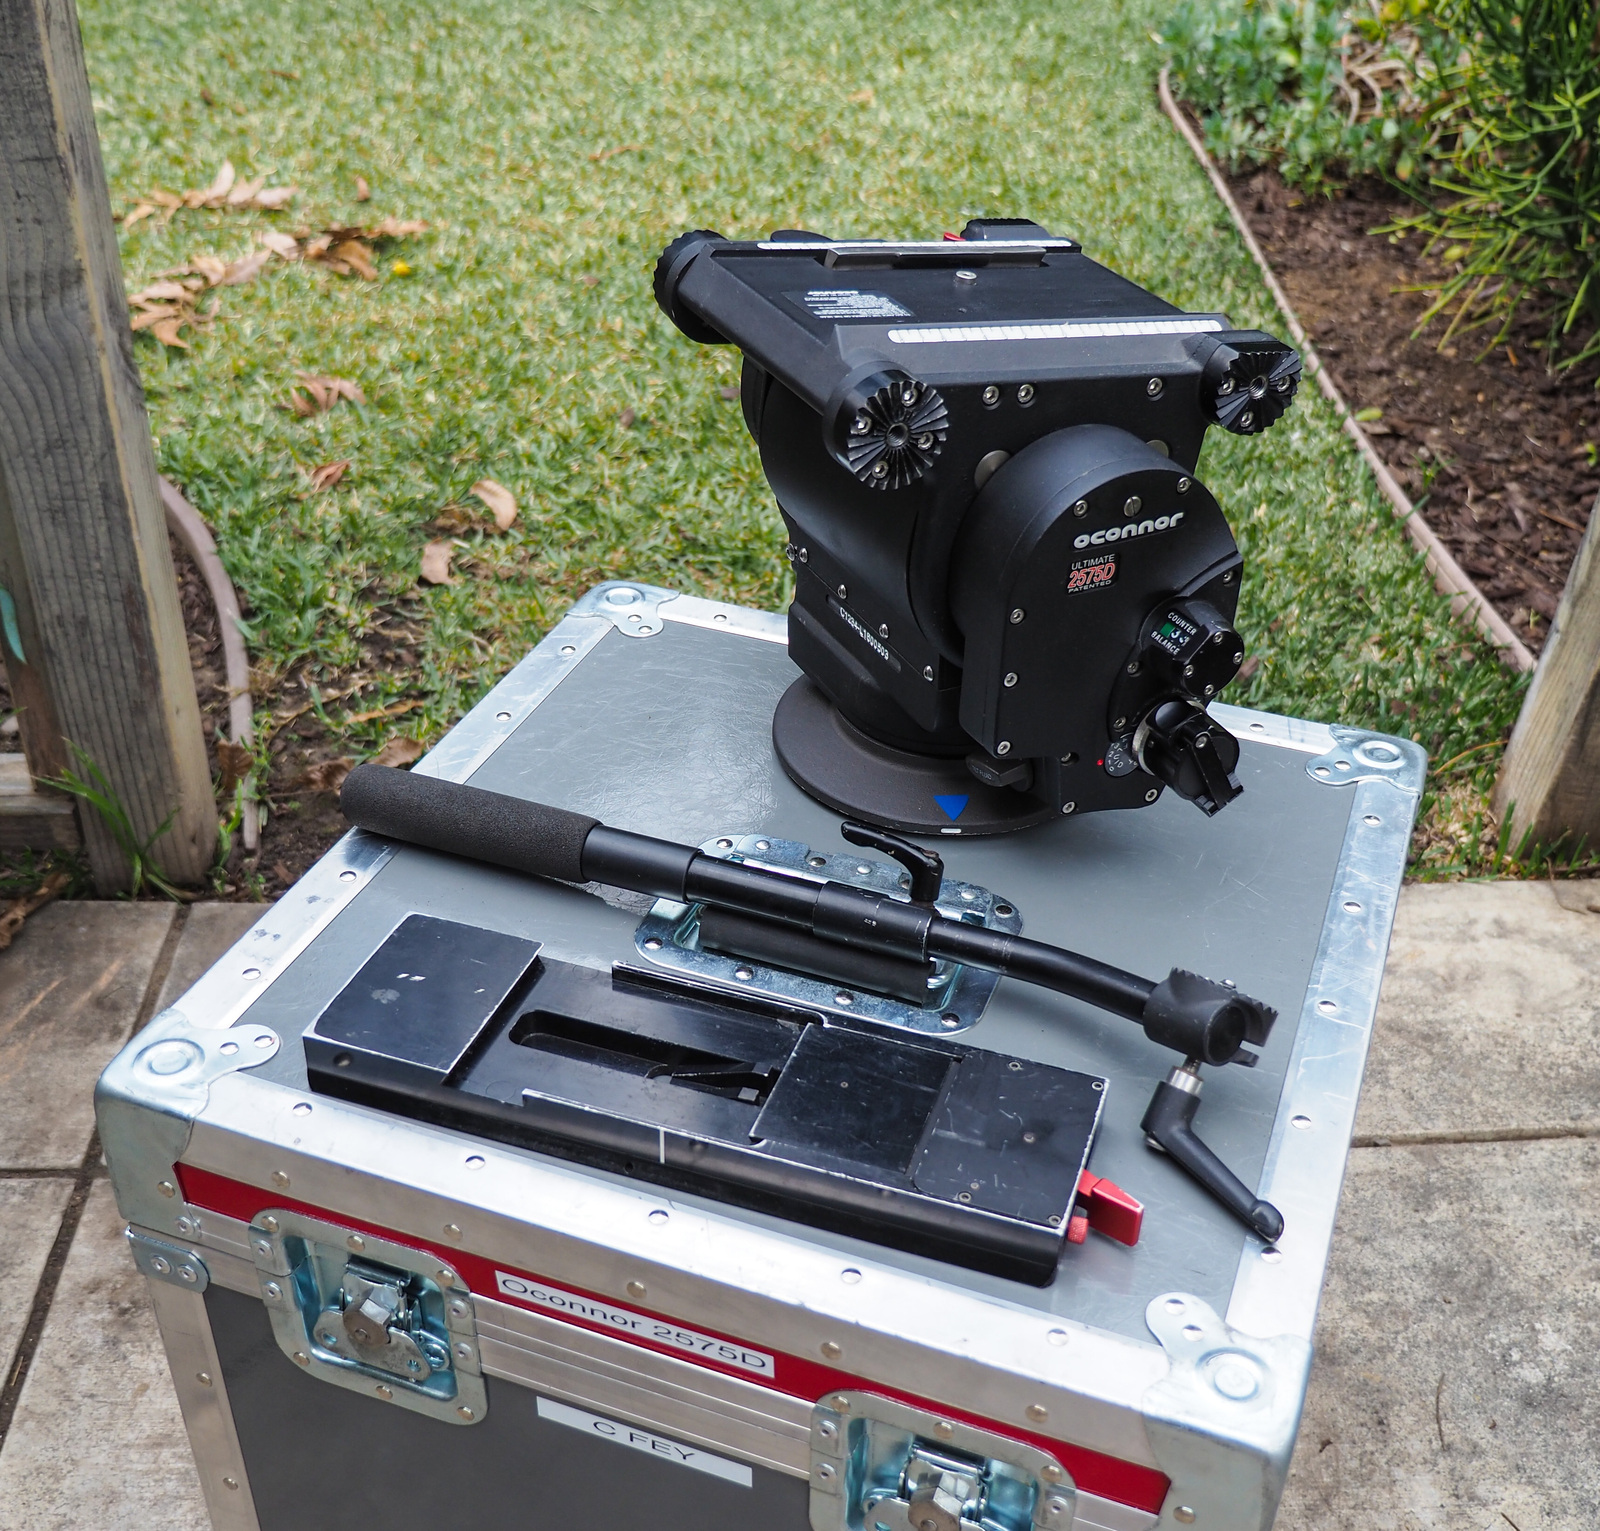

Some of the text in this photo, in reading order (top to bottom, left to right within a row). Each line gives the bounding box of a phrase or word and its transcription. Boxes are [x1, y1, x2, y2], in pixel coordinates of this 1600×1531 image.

[1073, 511, 1184, 549] oconnor
[1071, 553, 1115, 571] ULTIMATE
[1067, 562, 1116, 589] 2575D
[1067, 579, 1112, 594] PATENTED
[1167, 611, 1197, 636] COUNTER
[1150, 630, 1180, 655] BALANCE
[502, 1279, 767, 1369] Oconnor 2575D
[593, 1421, 695, 1461] C FEY
